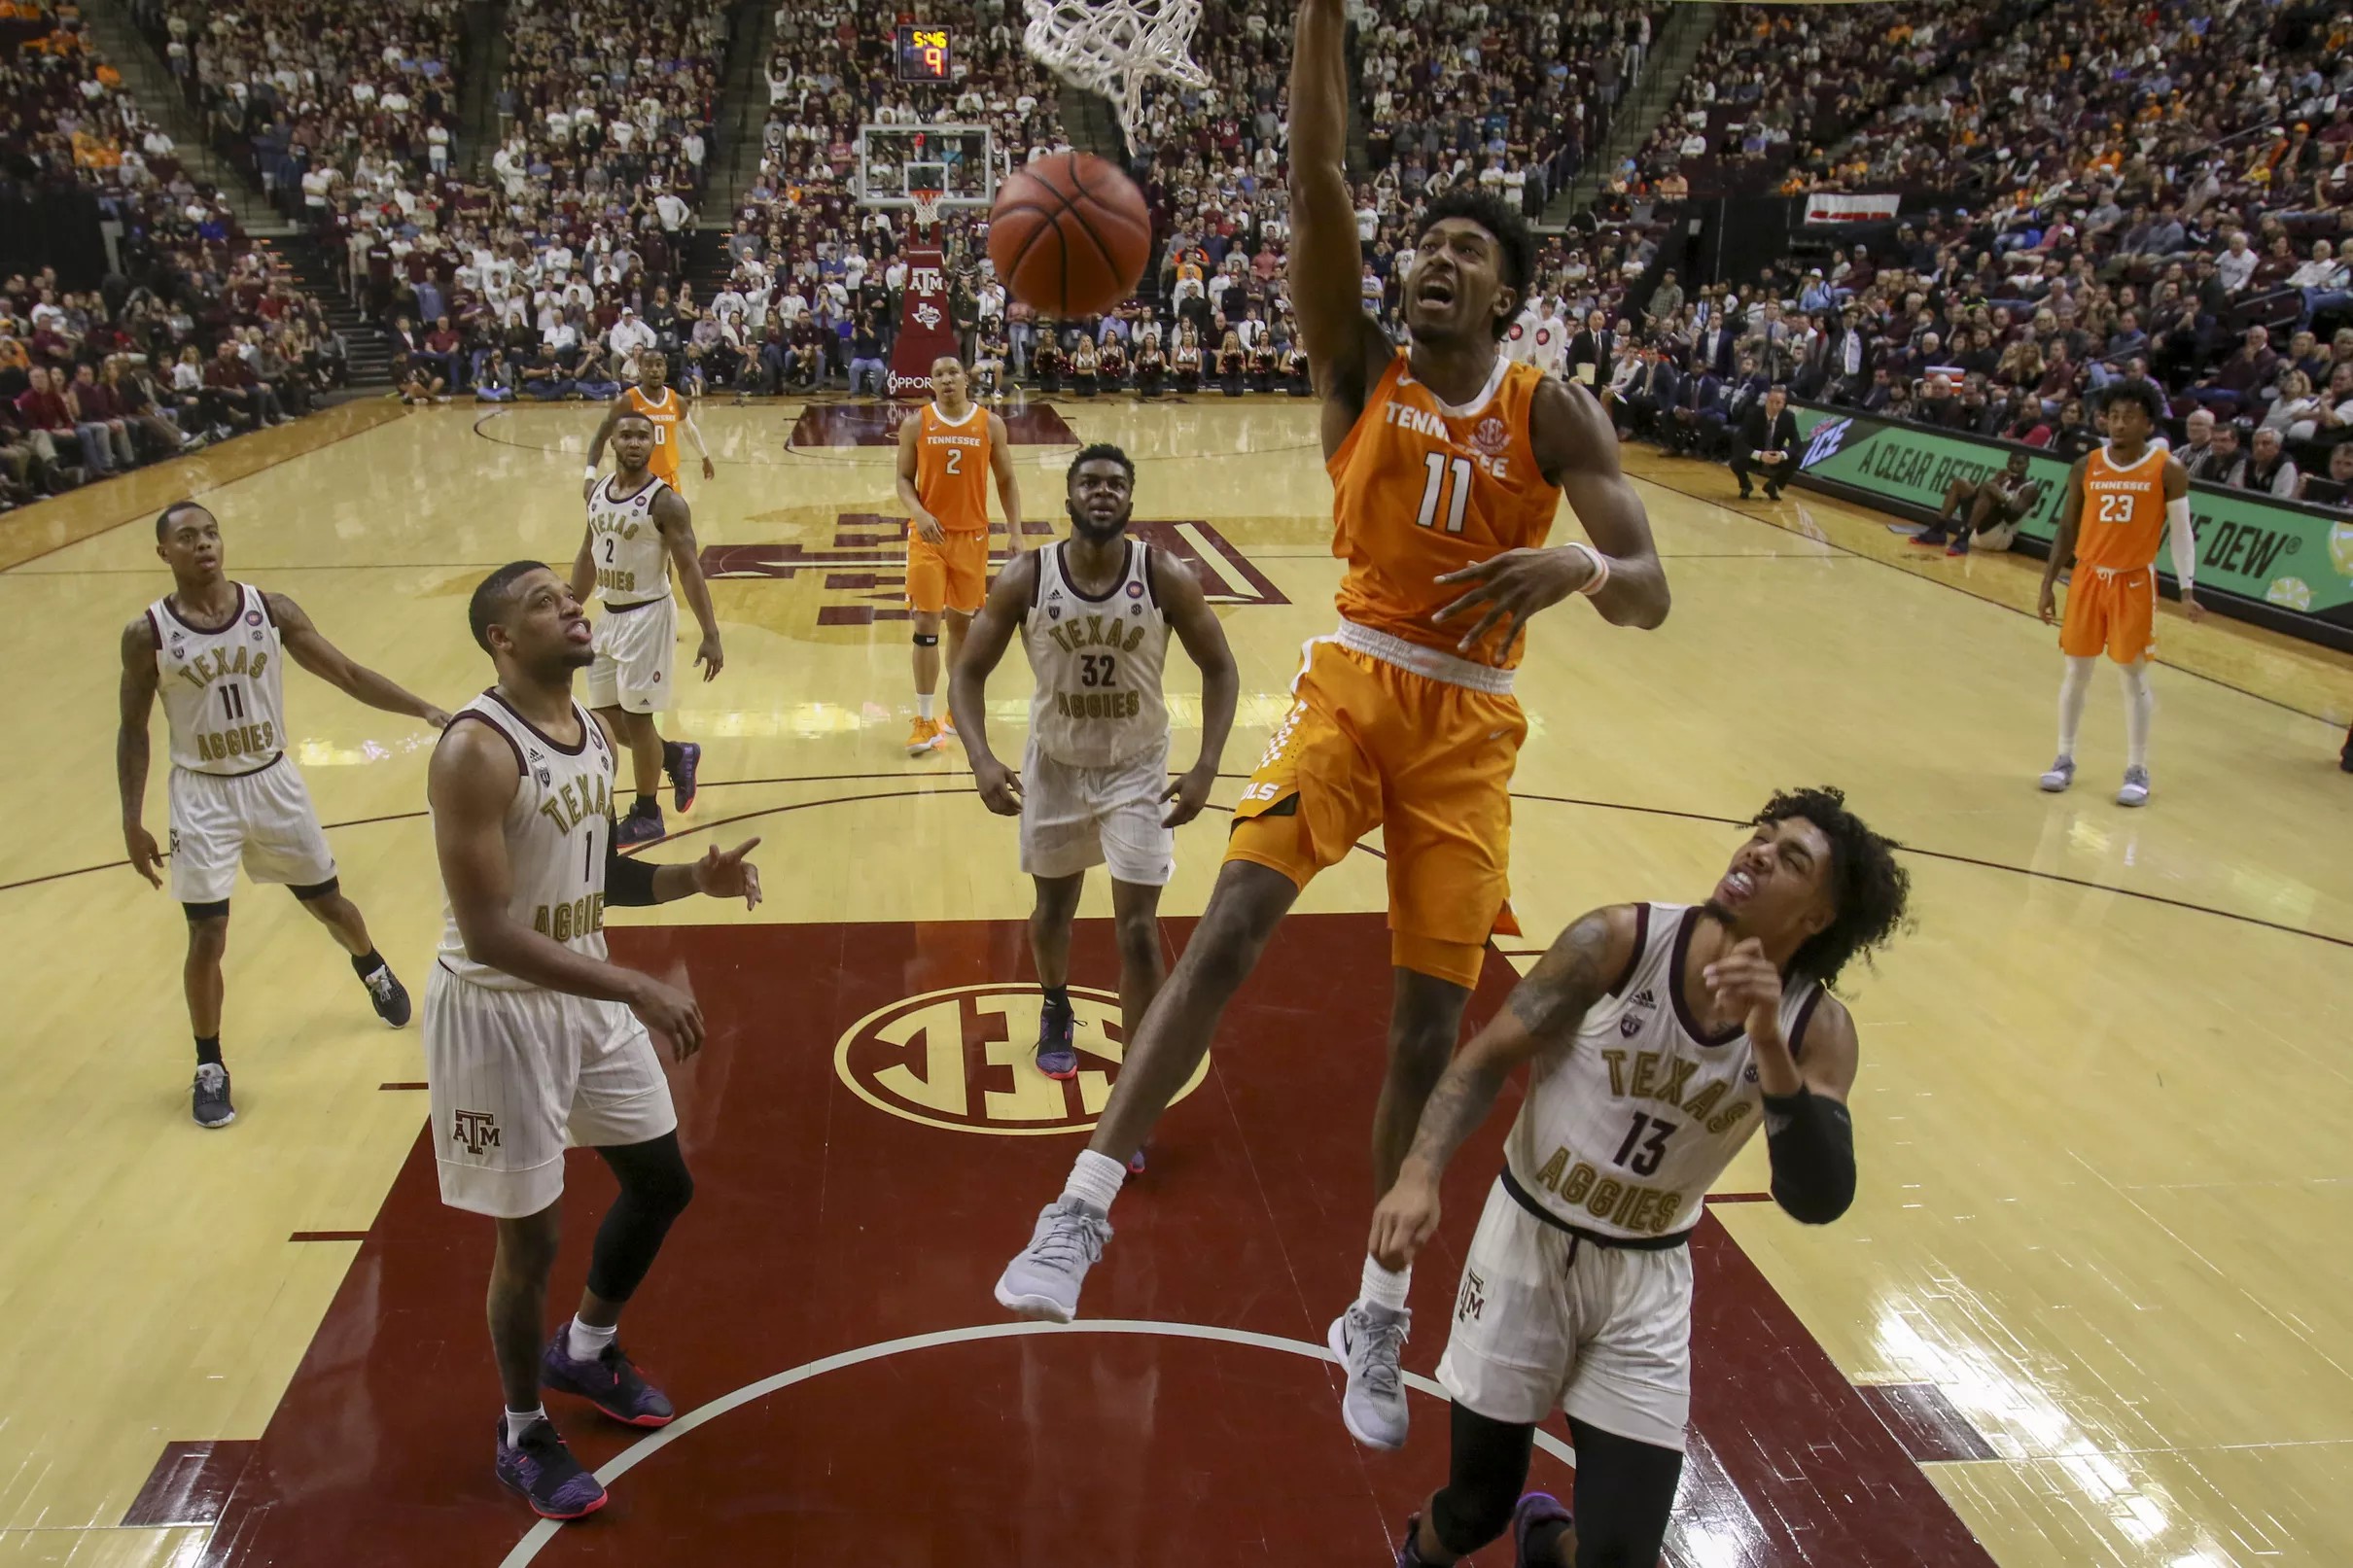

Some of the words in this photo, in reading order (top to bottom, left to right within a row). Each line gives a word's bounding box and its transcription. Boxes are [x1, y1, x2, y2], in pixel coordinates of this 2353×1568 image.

[912, 31, 947, 48] 5:46
[926, 49, 943, 75] 9
[909, 267, 943, 296] ATM
[887, 370, 932, 394] OPPOR
[927, 436, 981, 446] TENNESSEE
[1799, 417, 1854, 470] ICE
[946, 448, 962, 474] 2
[1858, 440, 1879, 474] A
[1874, 443, 1930, 487] CLEAR
[1417, 451, 1472, 533] 11
[2090, 480, 2152, 492] TENNESSEE
[590, 511, 640, 540] TEXAS
[2099, 494, 2135, 522] 23
[606, 538, 615, 563] 2
[596, 567, 635, 592] GGIES
[1048, 615, 1145, 653] TEXAS
[178, 645, 268, 690] TEXAS
[1080, 654, 1116, 687] 32
[219, 682, 244, 720] 11
[1058, 689, 1140, 719] AGGIES
[197, 720, 275, 761] AGGIES
[584, 830, 592, 883] 1
[534, 891, 605, 943] AGGIE
[1601, 1049, 1752, 1134] TEXAS
[452, 1109, 501, 1155] ATM
[1612, 1110, 1678, 1177] 13
[1535, 1145, 1683, 1234] AGGIES
